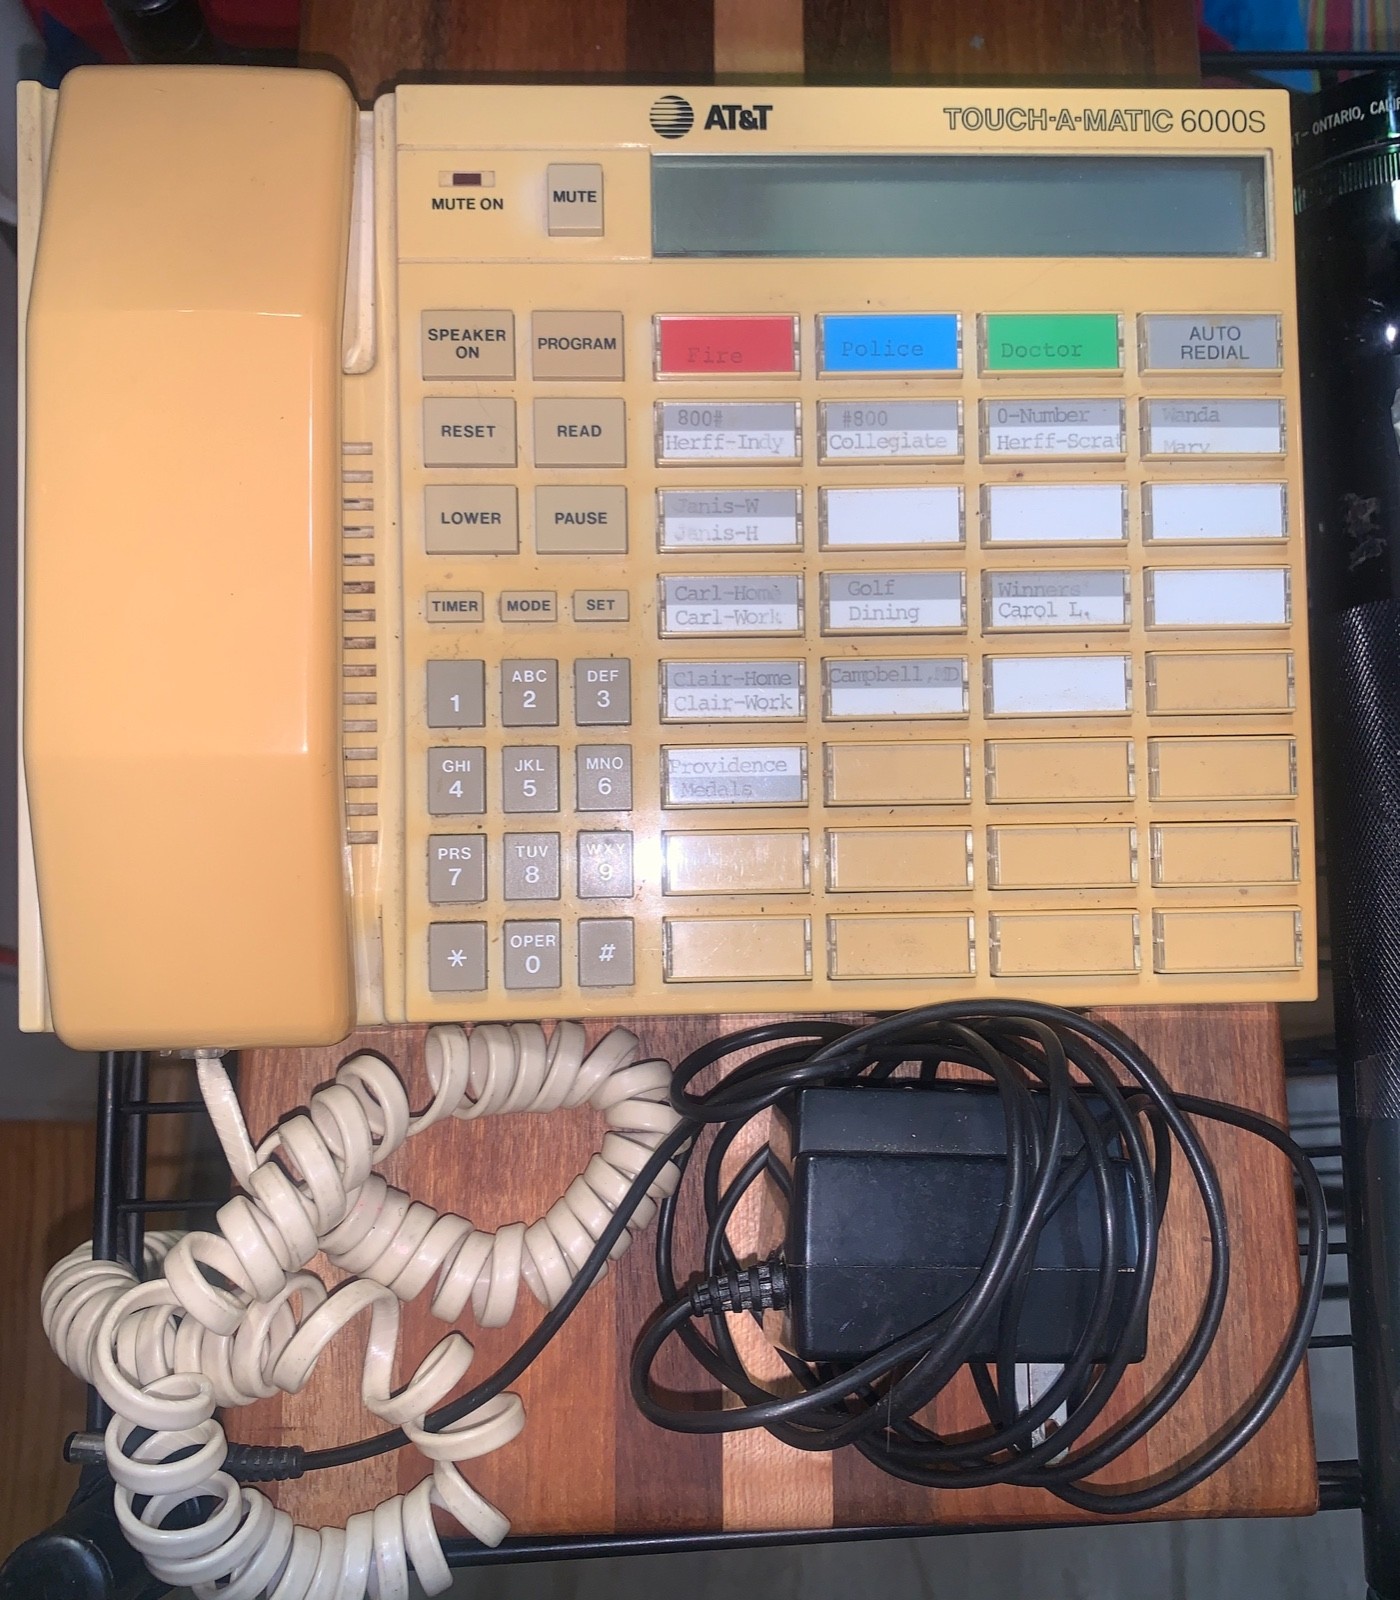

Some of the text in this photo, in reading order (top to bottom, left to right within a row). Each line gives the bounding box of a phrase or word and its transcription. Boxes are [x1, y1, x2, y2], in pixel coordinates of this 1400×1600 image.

[704, 105, 773, 130] AT&T
[943, 107, 1266, 133] TOUCH-A-MATIC 6000S
[1312, 105, 1365, 135] ONTARIO,
[431, 198, 504, 211] MUTE ON
[552, 190, 598, 204] MUTE
[428, 328, 507, 342] SPEAKER
[1189, 326, 1241, 341] AUTO
[537, 337, 617, 350] PROGRAM
[841, 340, 925, 358] Police
[1000, 342, 1083, 359] Doctor
[455, 346, 480, 359] ON
[687, 346, 744, 364] Fire
[1180, 345, 1250, 360] REDIAL
[677, 409, 724, 427] 800#
[842, 410, 889, 427] #800
[1162, 406, 1221, 424] Wanda
[441, 425, 496, 438] RESET
[556, 425, 602, 438] READ
[665, 434, 784, 454] Herff-Indy
[829, 432, 948, 453] Collegiate
[674, 498, 760, 514] Janis-W
[441, 512, 502, 525] LOWER
[555, 512, 607, 525] PAUSE
[674, 525, 759, 542] Janis-H
[847, 580, 895, 597] Golf
[431, 600, 478, 613] TIMER
[506, 600, 551, 612] MODE
[586, 599, 615, 611] SET
[998, 601, 1057, 618] Carol
[675, 609, 782, 625] Carl-Work
[848, 605, 921, 624] Dining
[511, 670, 548, 683] ABC
[587, 670, 620, 682] DEF
[673, 671, 792, 687] Clair-Home
[449, 694, 460, 712] 1
[523, 691, 537, 708] 2
[597, 690, 611, 708] 3
[674, 694, 793, 711] Clair-Work
[442, 760, 471, 773] GHI
[514, 759, 545, 772] JKL
[586, 757, 624, 770] MNO
[668, 757, 788, 775] Providence
[449, 780, 463, 798] 4
[523, 780, 537, 797] 5
[598, 778, 612, 795] 6
[680, 781, 752, 798] Medals
[438, 847, 472, 860] PRS
[515, 845, 549, 858] TUV
[586, 843, 625, 856] WXY
[448, 868, 462, 885] 7
[525, 866, 539, 883] 8
[599, 863, 613, 881] 9
[510, 935, 556, 948] OPER
[599, 944, 616, 962] #
[525, 956, 541, 974] 0
